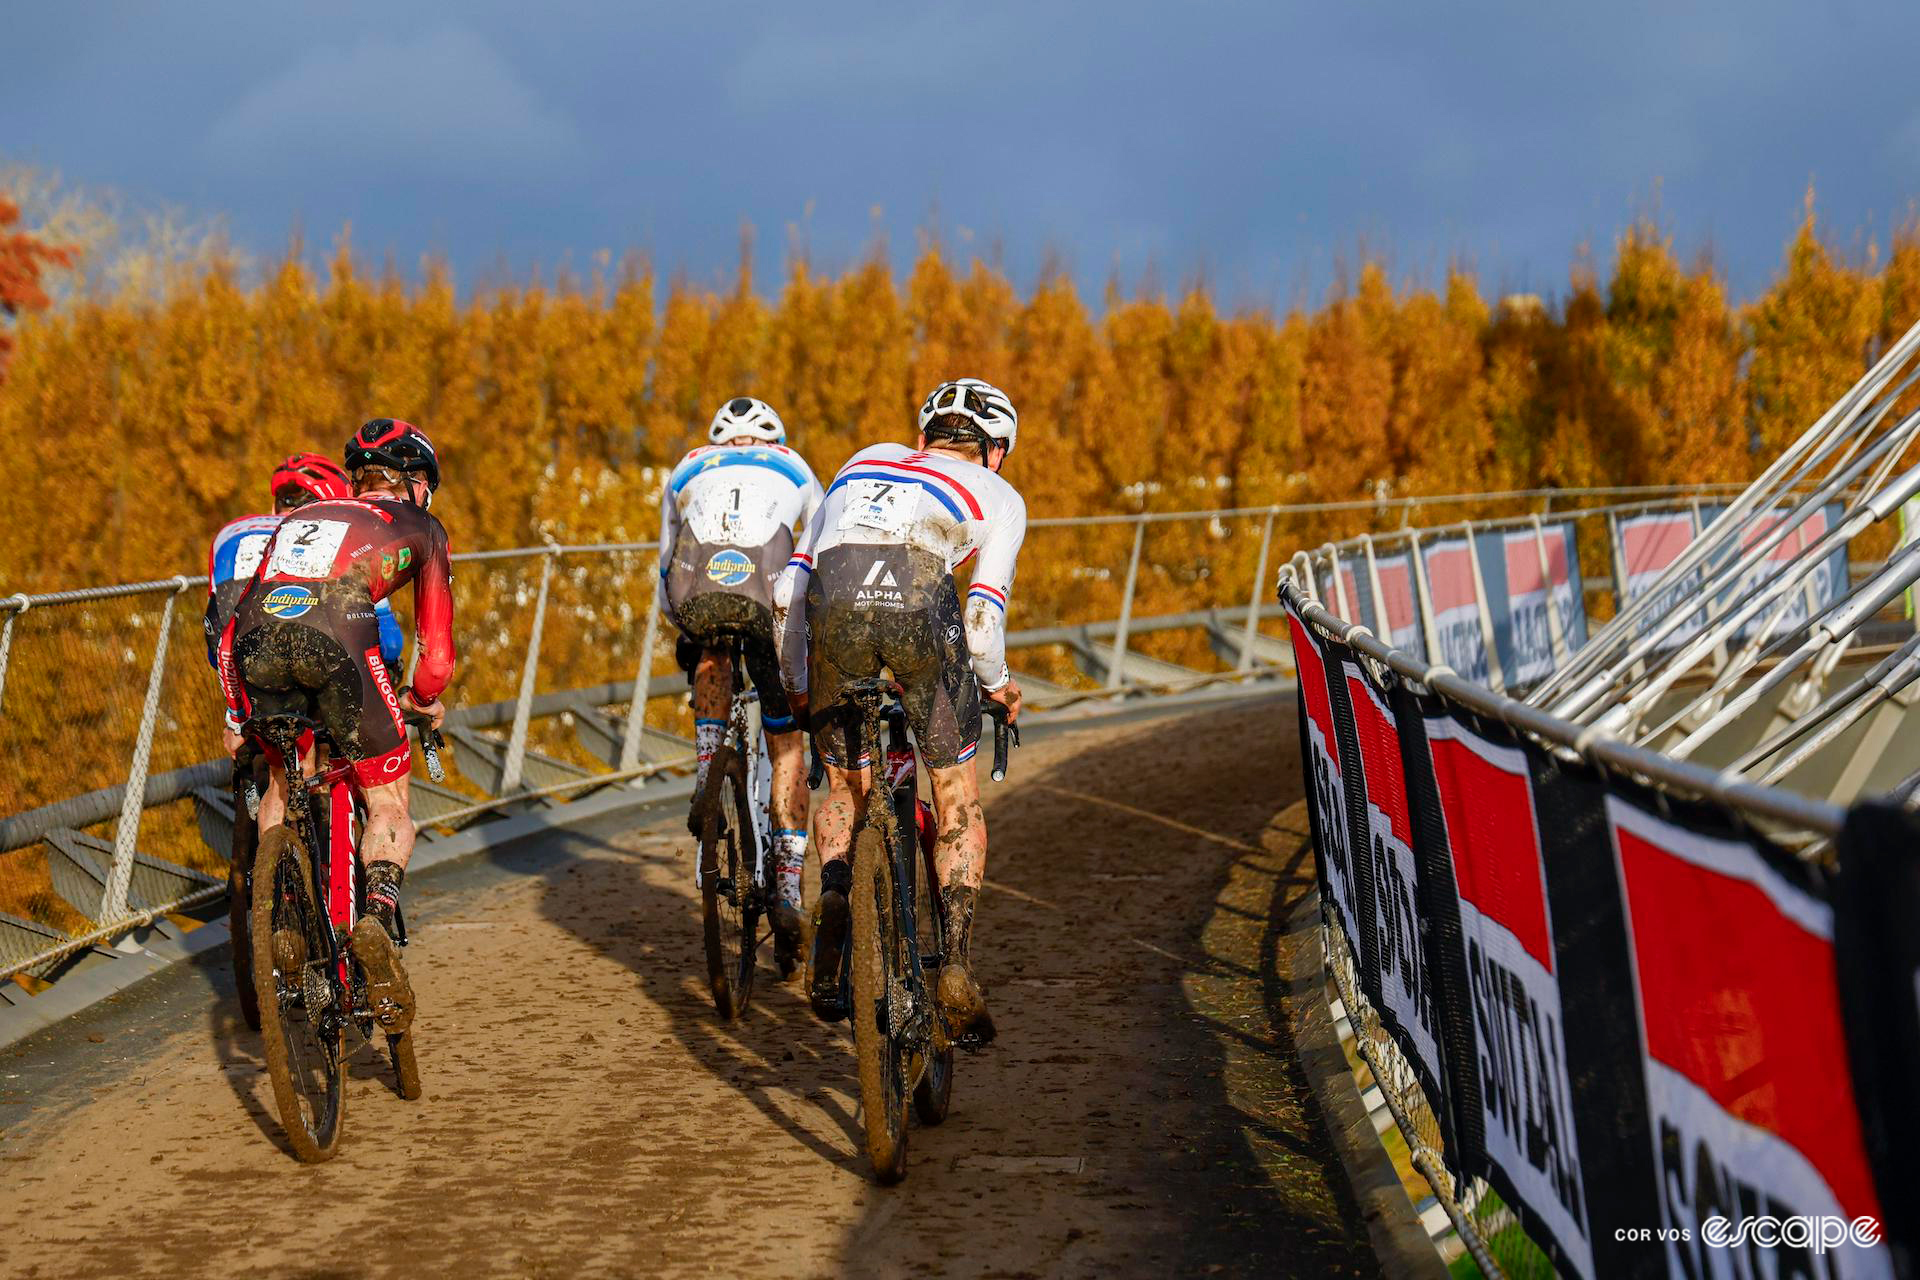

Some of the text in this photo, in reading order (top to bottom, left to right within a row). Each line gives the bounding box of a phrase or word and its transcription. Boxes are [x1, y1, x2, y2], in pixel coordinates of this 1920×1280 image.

[730, 488, 741, 511] 1
[871, 482, 894, 503] 7
[294, 523, 320, 546] 2
[705, 558, 756, 574] Andiprim
[262, 593, 319, 607] Andiprim
[856, 590, 903, 601] ALPHA
[854, 601, 905, 609] MOTORHOMES
[368, 654, 405, 730] BINGOAL
